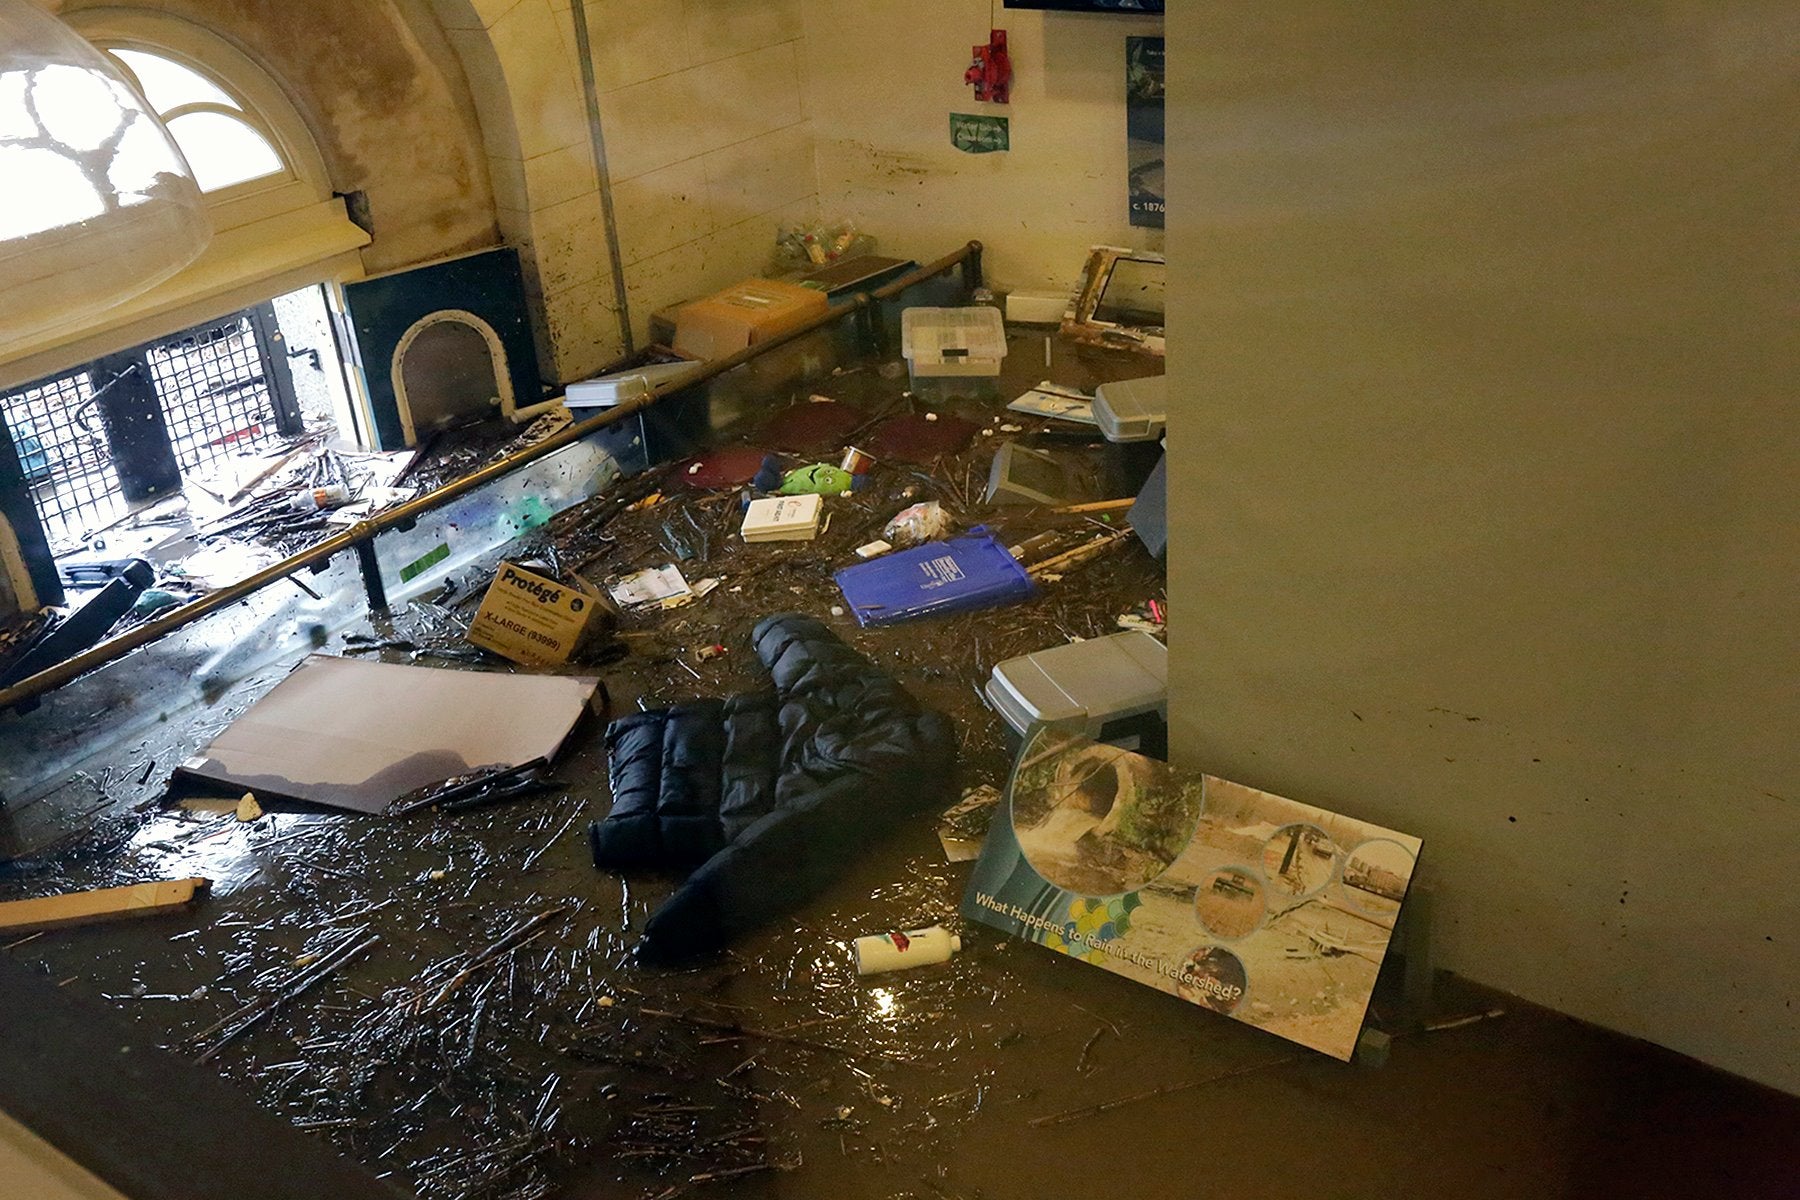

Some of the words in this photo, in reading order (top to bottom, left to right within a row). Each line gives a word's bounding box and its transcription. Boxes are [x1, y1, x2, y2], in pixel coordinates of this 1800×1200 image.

[1143, 202, 1165, 212] 1876
[484, 611, 526, 635] X-LARGE
[975, 891, 1009, 915] What
[1009, 905, 1066, 936] Happens
[1067, 928, 1082, 941] to
[1085, 933, 1114, 953] Rain
[1115, 944, 1127, 960] in
[1132, 950, 1153, 969] the
[1156, 959, 1242, 1001] Watershed?
